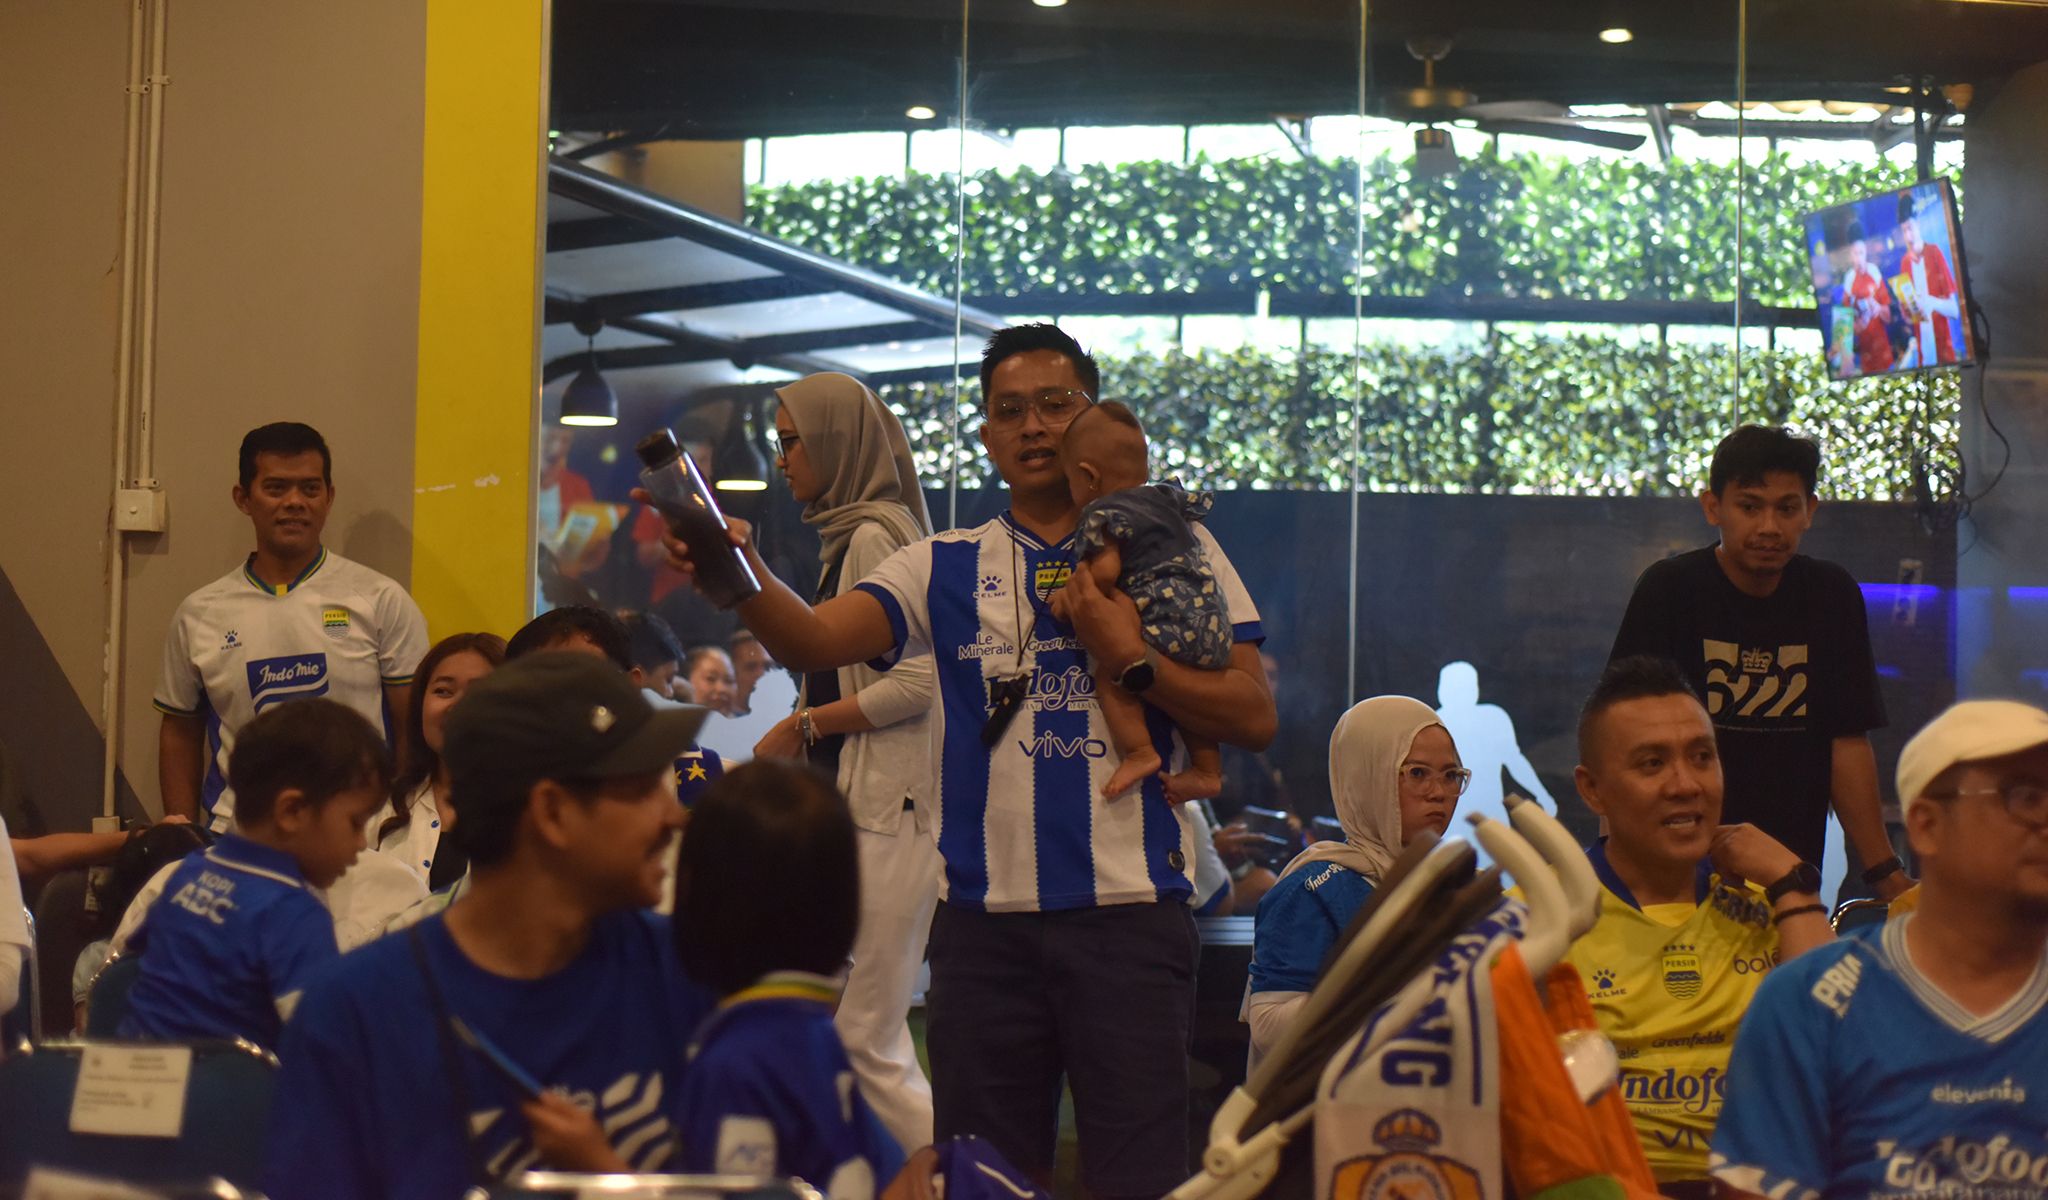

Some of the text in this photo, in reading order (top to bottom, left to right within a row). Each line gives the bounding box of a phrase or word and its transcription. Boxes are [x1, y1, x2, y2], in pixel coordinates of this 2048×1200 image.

[973, 591, 1007, 599] KELME
[976, 632, 993, 646] Le
[958, 642, 1014, 660] Minerale
[1018, 730, 1107, 758] vivo
[198, 870, 236, 895] KOPI
[171, 881, 236, 925] ABC
[1664, 959, 1697, 968] PERSIB
[1587, 987, 1627, 999] KELME
[1651, 1032, 1725, 1048] Greenfields
[1930, 1076, 2026, 1104] elevenia
